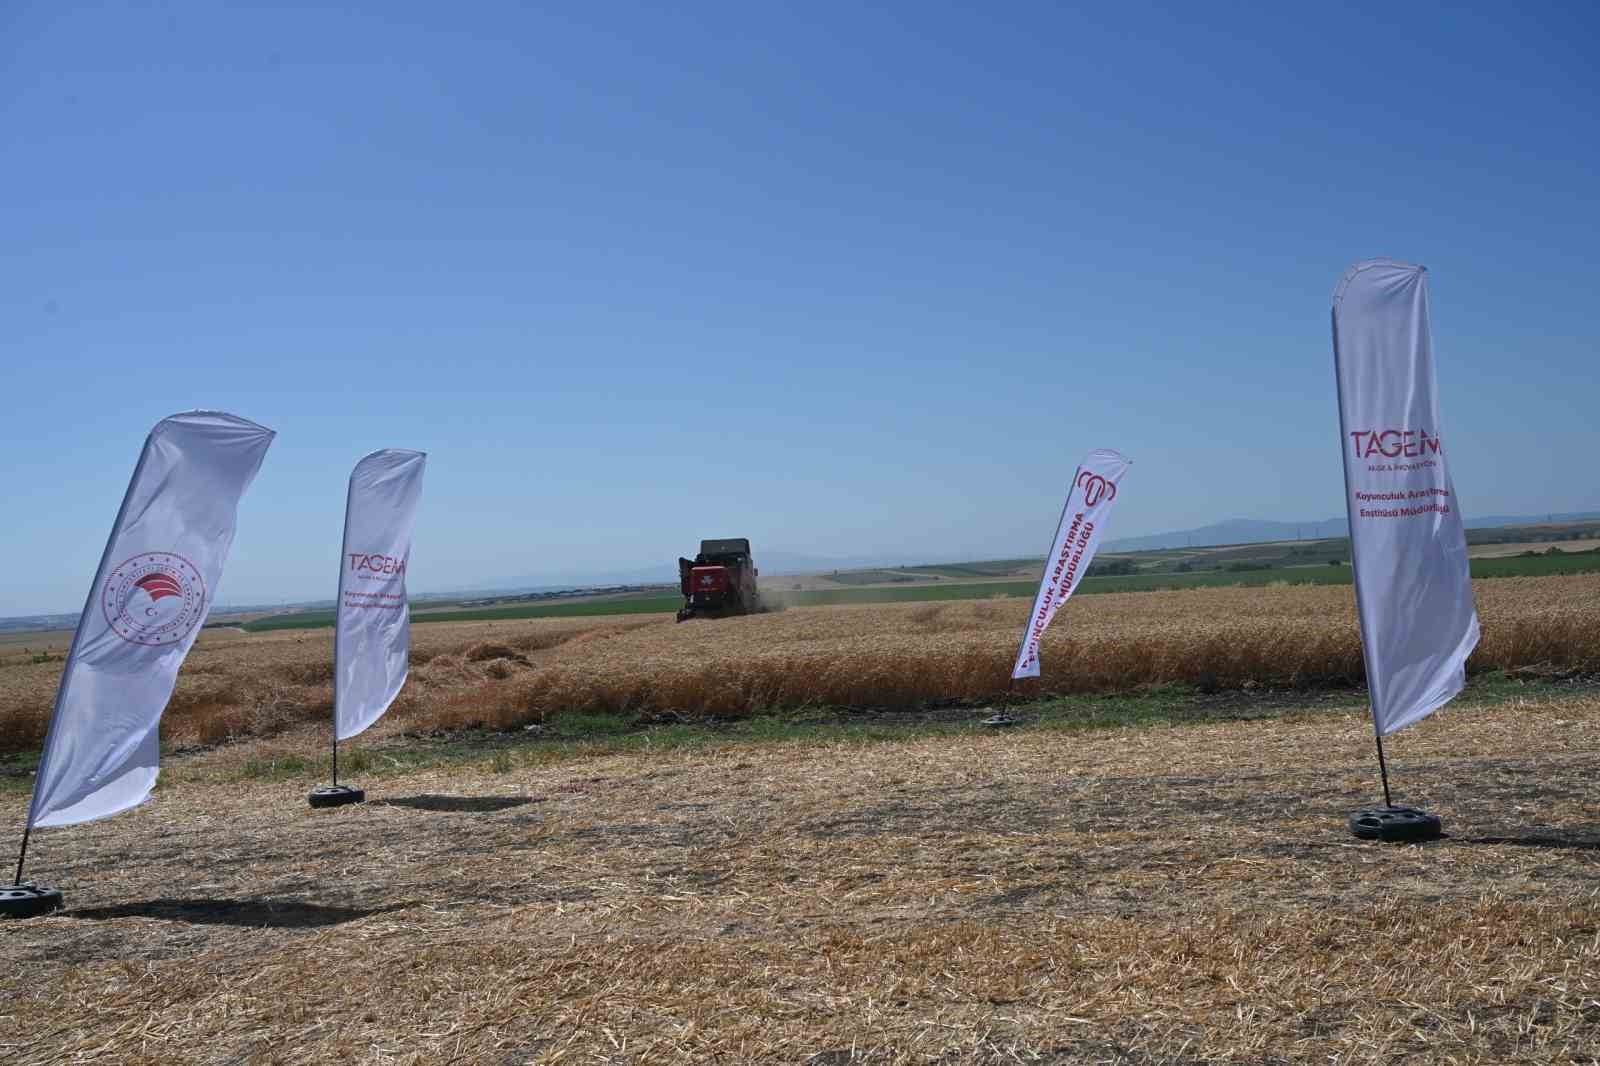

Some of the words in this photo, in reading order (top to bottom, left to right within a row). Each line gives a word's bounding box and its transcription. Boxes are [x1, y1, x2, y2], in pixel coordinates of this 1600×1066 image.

[1350, 429, 1442, 458] TAGEM
[1052, 512, 1084, 584] ARAŞTIRMA
[1059, 522, 1094, 598] MÜDÜRLÜĞÜ
